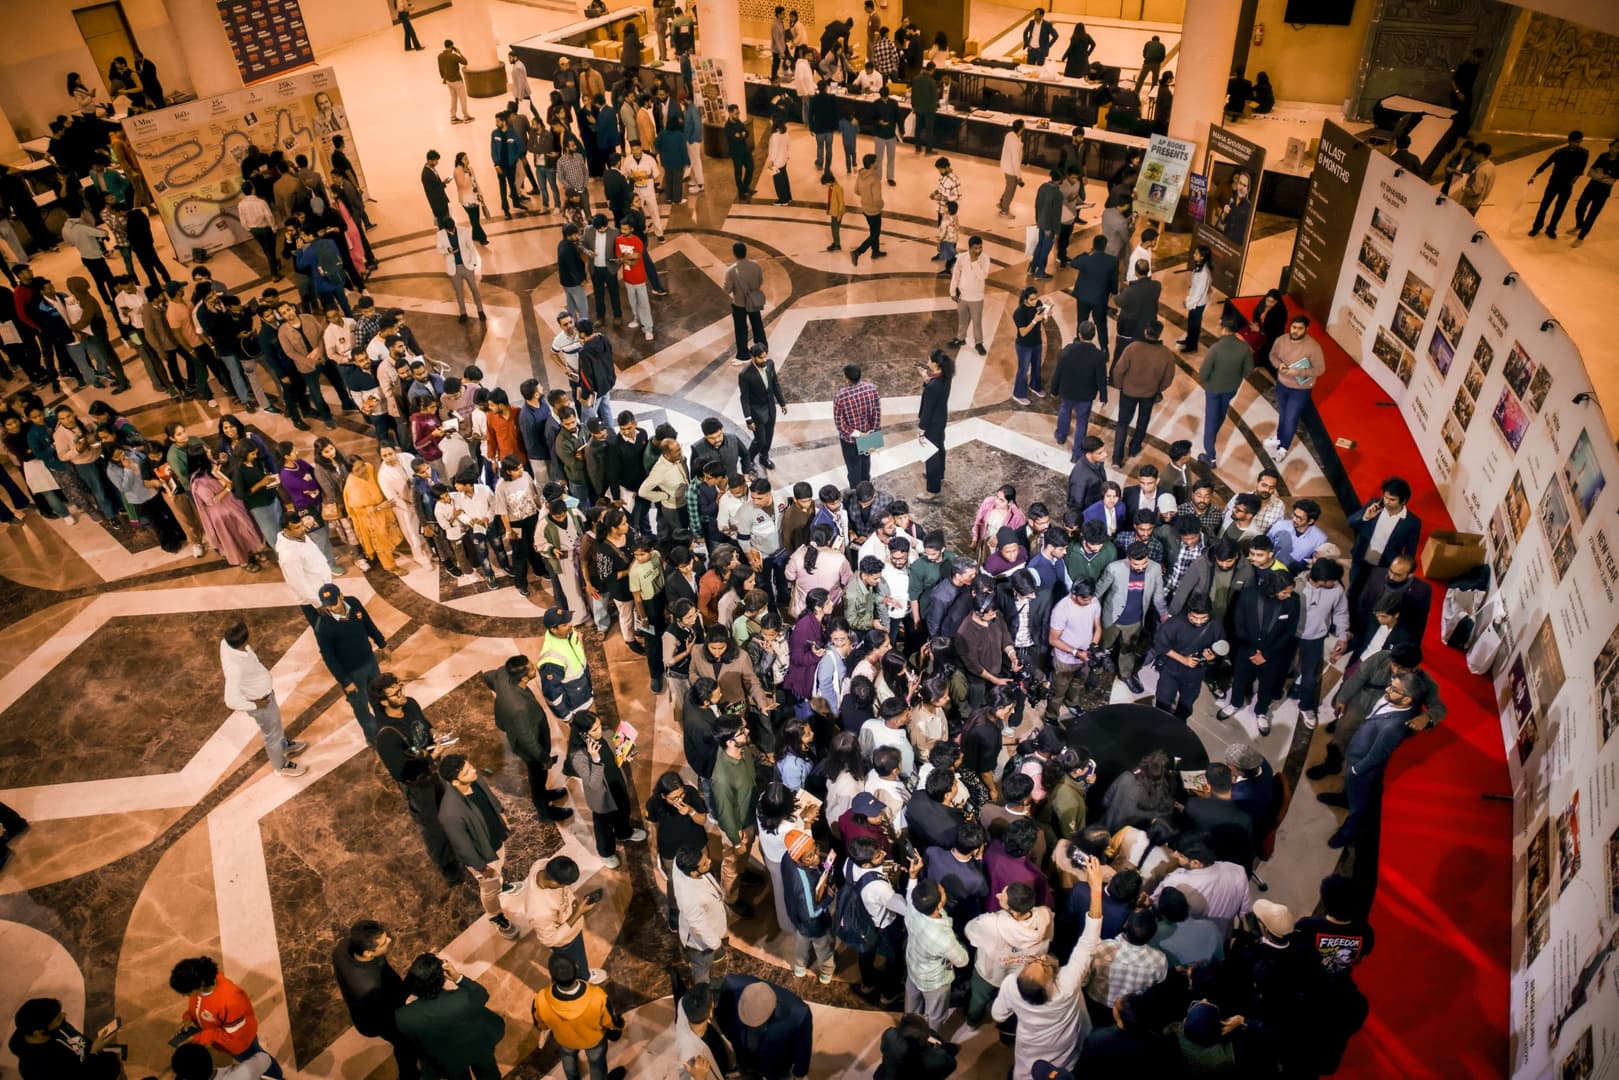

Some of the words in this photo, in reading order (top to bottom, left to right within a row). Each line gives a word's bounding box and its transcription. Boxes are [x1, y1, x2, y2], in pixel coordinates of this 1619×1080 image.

[1150, 144, 1190, 161] PRESENTS
[1166, 140, 1187, 151] BOOKS
[1321, 137, 1329, 152] IN
[1328, 143, 1347, 163] LAST
[1318, 152, 1324, 164] 6
[1322, 155, 1350, 184] MONTHS
[1597, 528, 1609, 555] NEW
[1605, 551, 1619, 584] YEAR
[1320, 938, 1360, 947] FREEDOM
